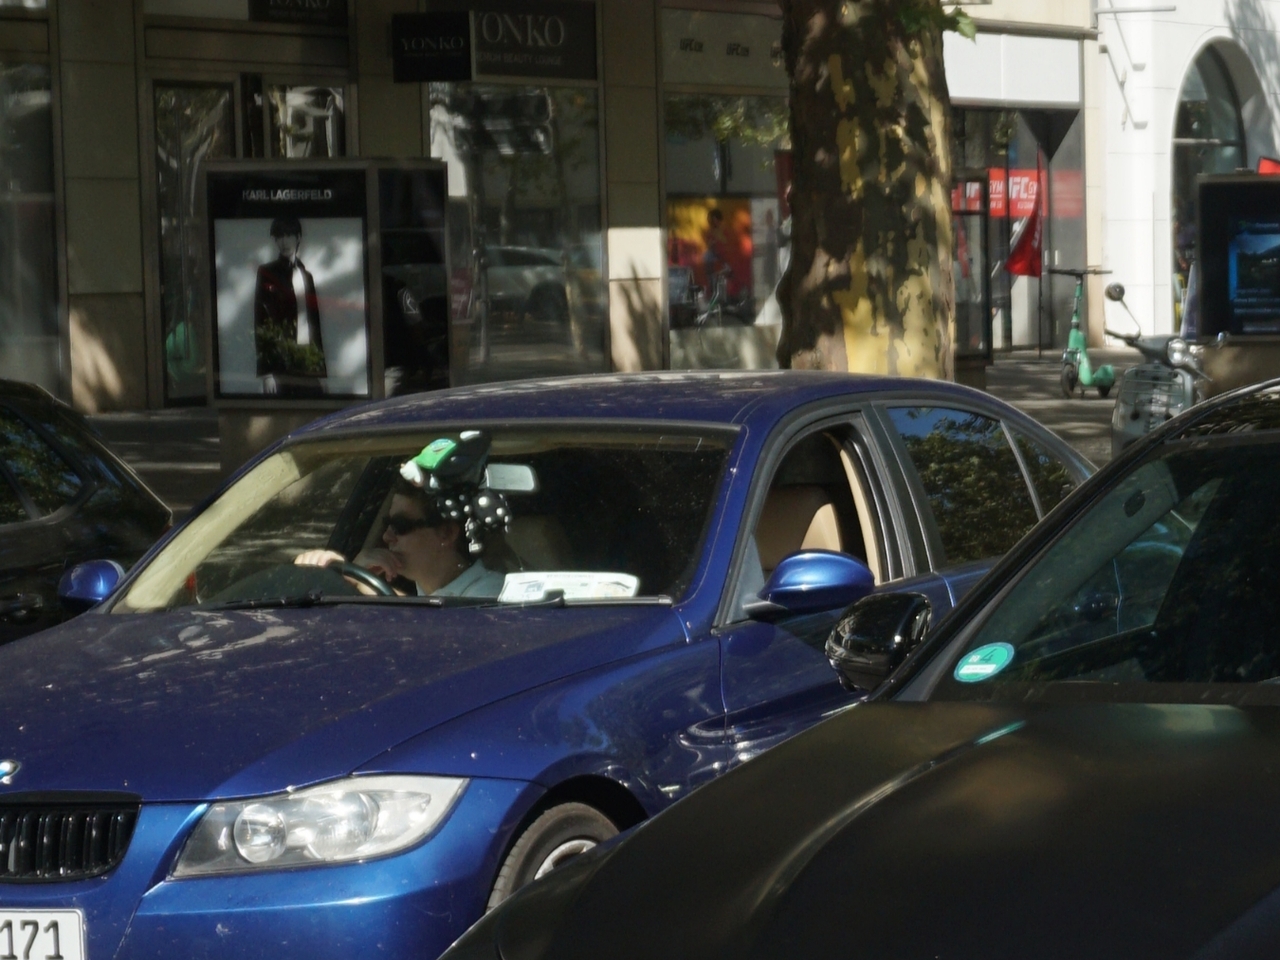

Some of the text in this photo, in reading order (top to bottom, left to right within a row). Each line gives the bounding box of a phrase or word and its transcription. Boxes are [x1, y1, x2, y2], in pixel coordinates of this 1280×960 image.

[400, 36, 464, 51] YONKO
[242, 189, 332, 201] KARL LAGERFELD
[0, 919, 64, 960] 171
